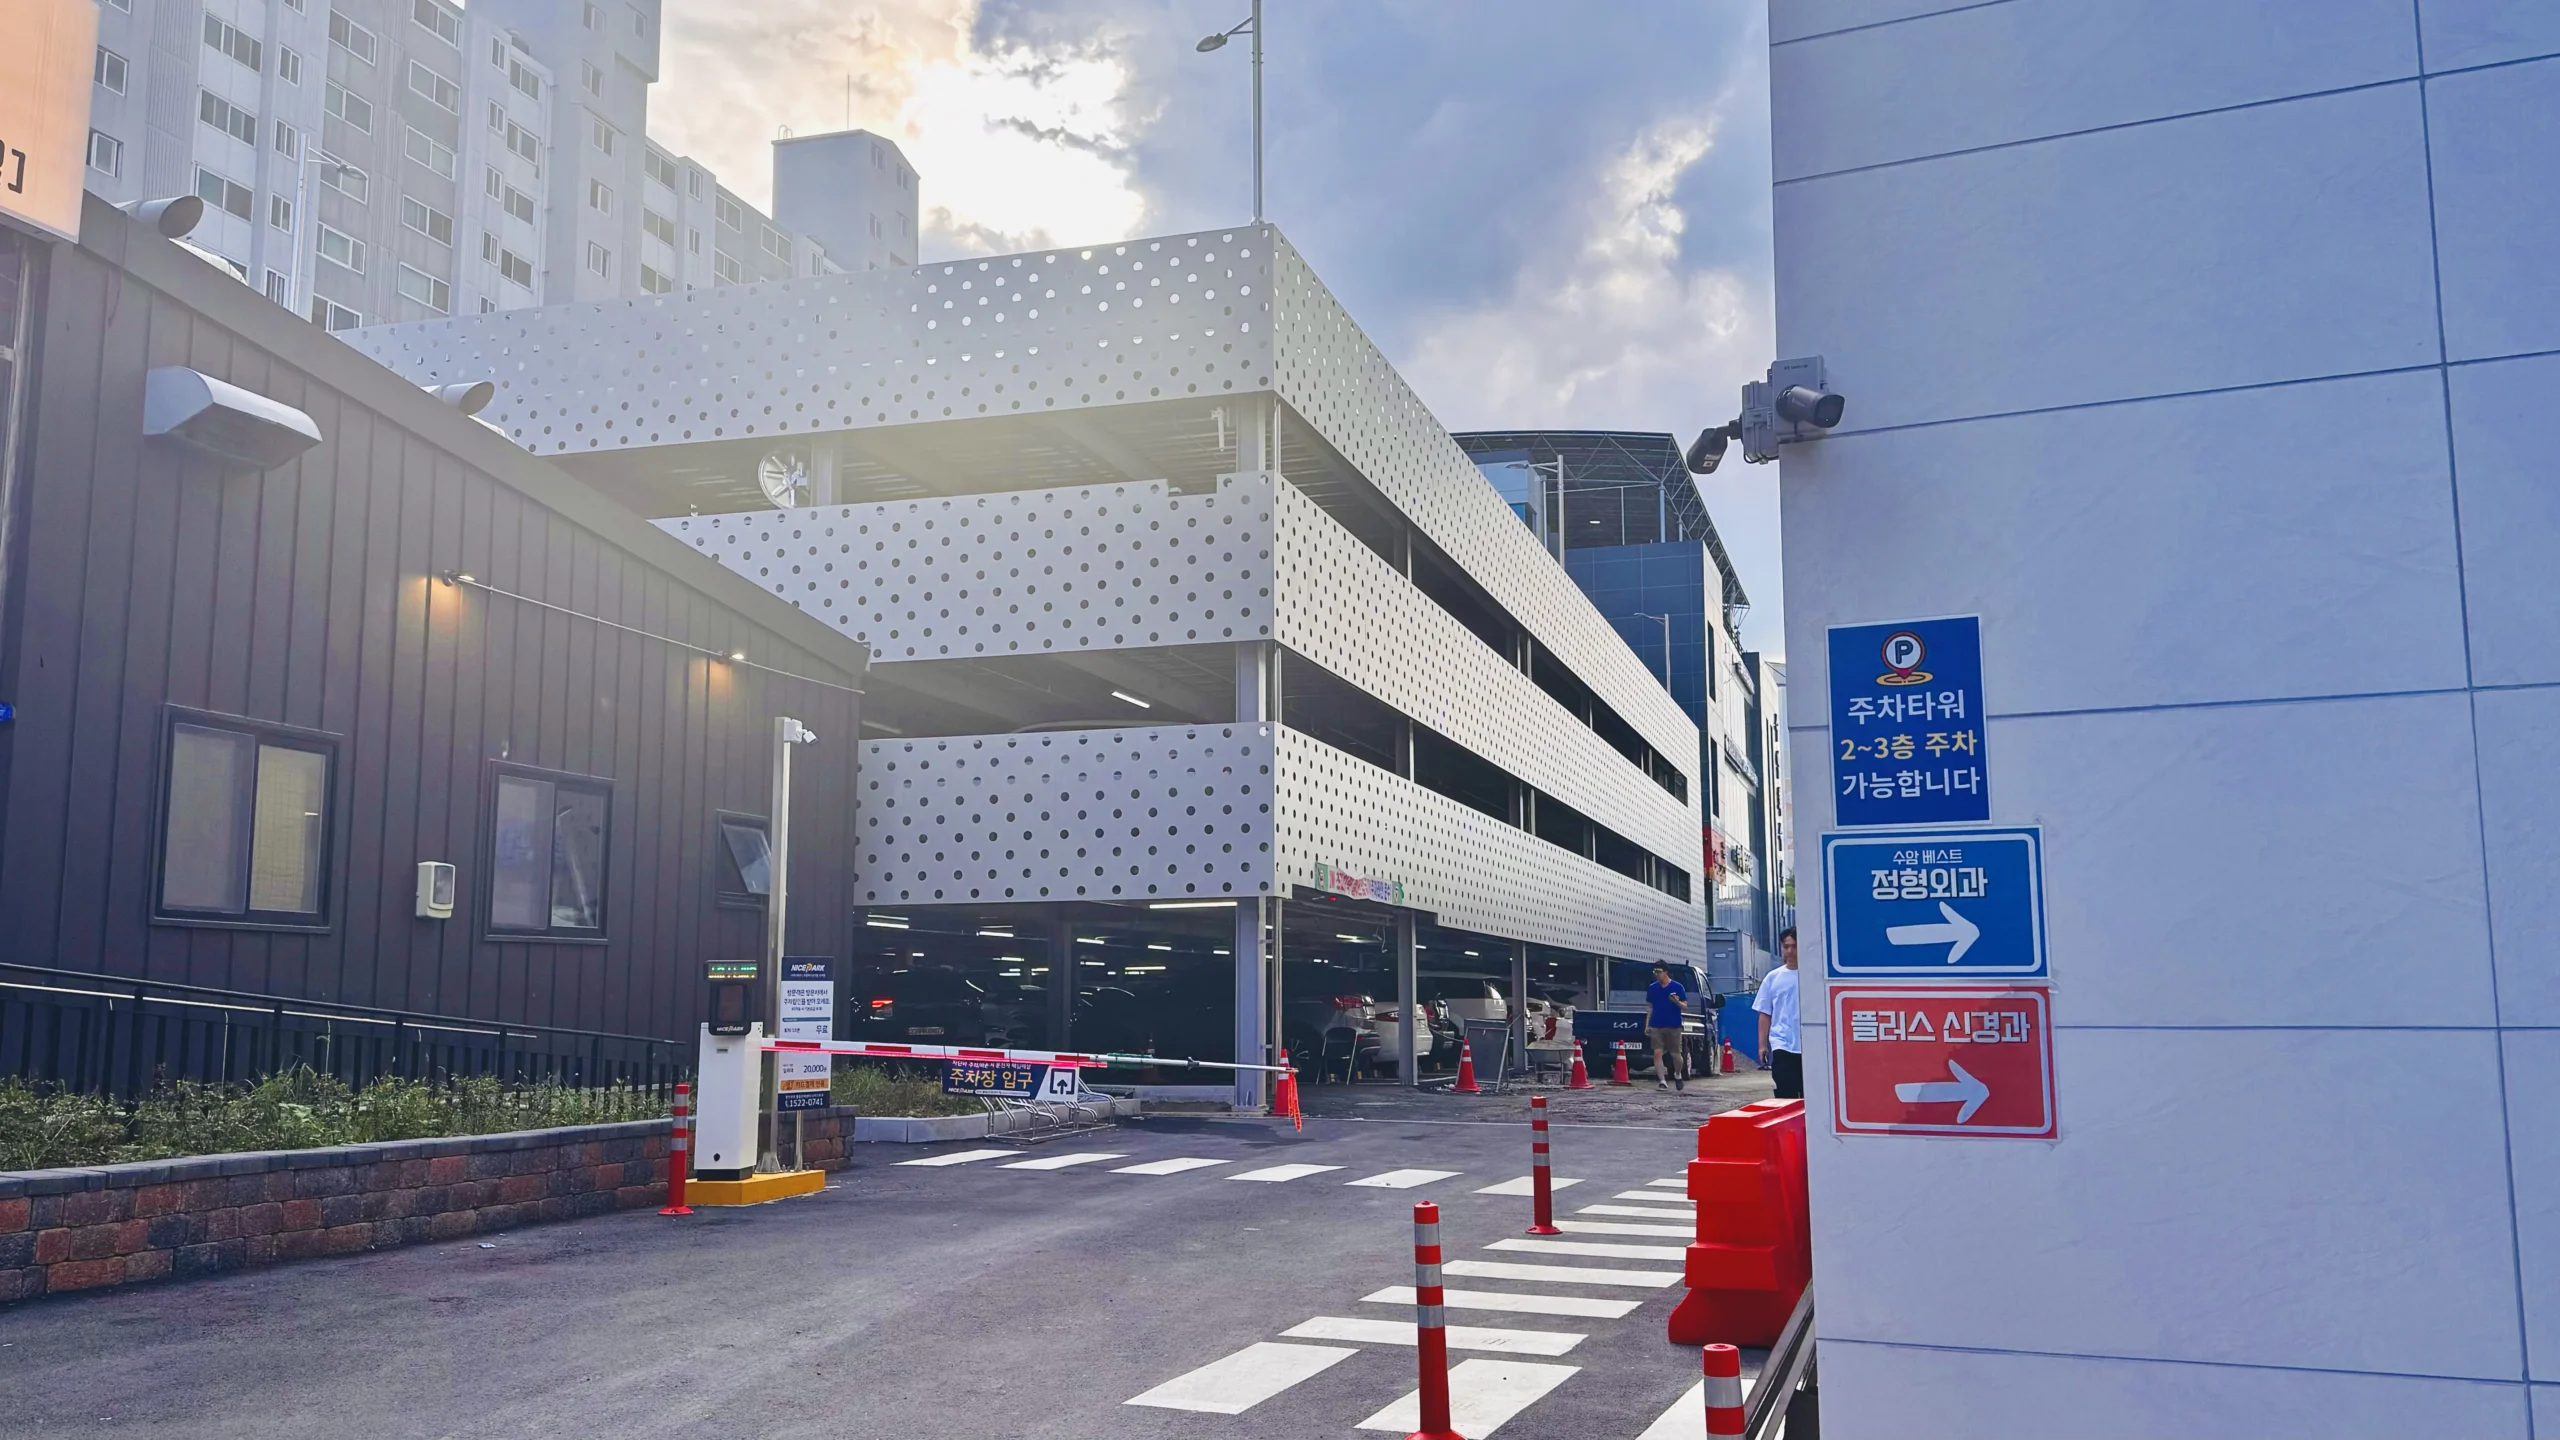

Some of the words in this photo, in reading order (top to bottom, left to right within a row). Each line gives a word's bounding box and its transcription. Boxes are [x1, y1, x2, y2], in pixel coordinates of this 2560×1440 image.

[1848, 689, 1965, 725] 주차타워
[1840, 734, 1916, 761] 2~3층
[1925, 729, 1978, 758] 주차
[1842, 766, 1980, 800] 가능합니다
[1892, 850, 1920, 866] 수암
[1922, 849, 1963, 865] 베스트
[1871, 867, 1988, 901] 정형외과
[790, 963, 825, 972] NICEPARK
[816, 1025, 828, 1034] 무료
[1851, 1010, 1936, 1043] 플러스
[1943, 1011, 2032, 1044] 신경과
[949, 1068, 997, 1088] 주차장
[1002, 1071, 1033, 1089] 입구
[789, 1097, 824, 1108] 1522-0741
